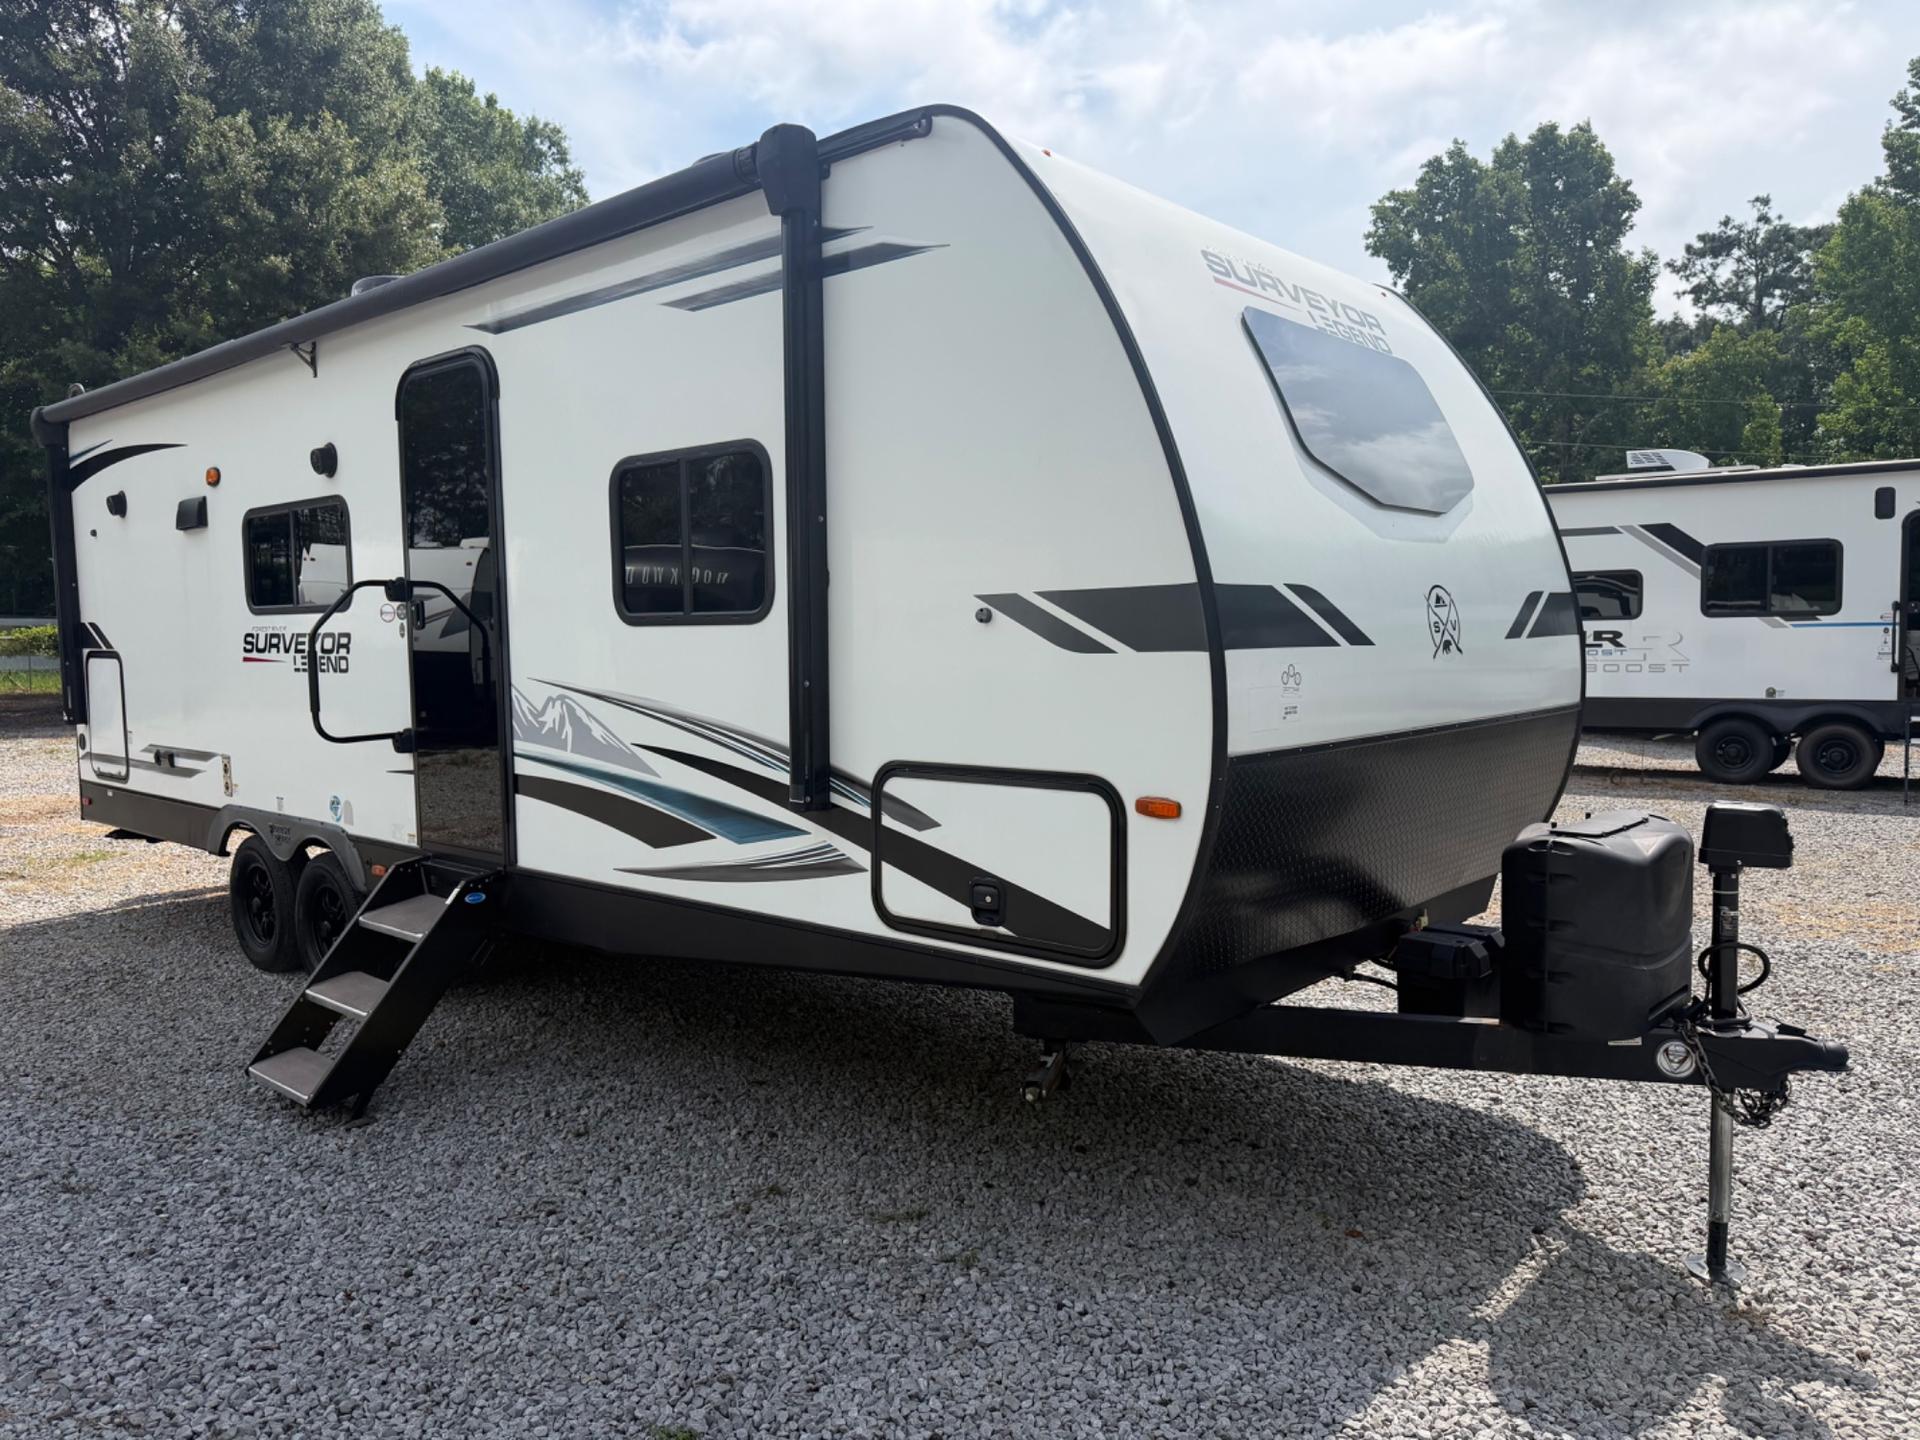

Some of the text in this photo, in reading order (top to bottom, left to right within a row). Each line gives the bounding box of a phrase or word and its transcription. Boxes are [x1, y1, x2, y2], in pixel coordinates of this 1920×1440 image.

[1200, 249, 1387, 336] SURVEYOR
[1306, 310, 1393, 354] LEGEND
[293, 655, 349, 673] LEEND
